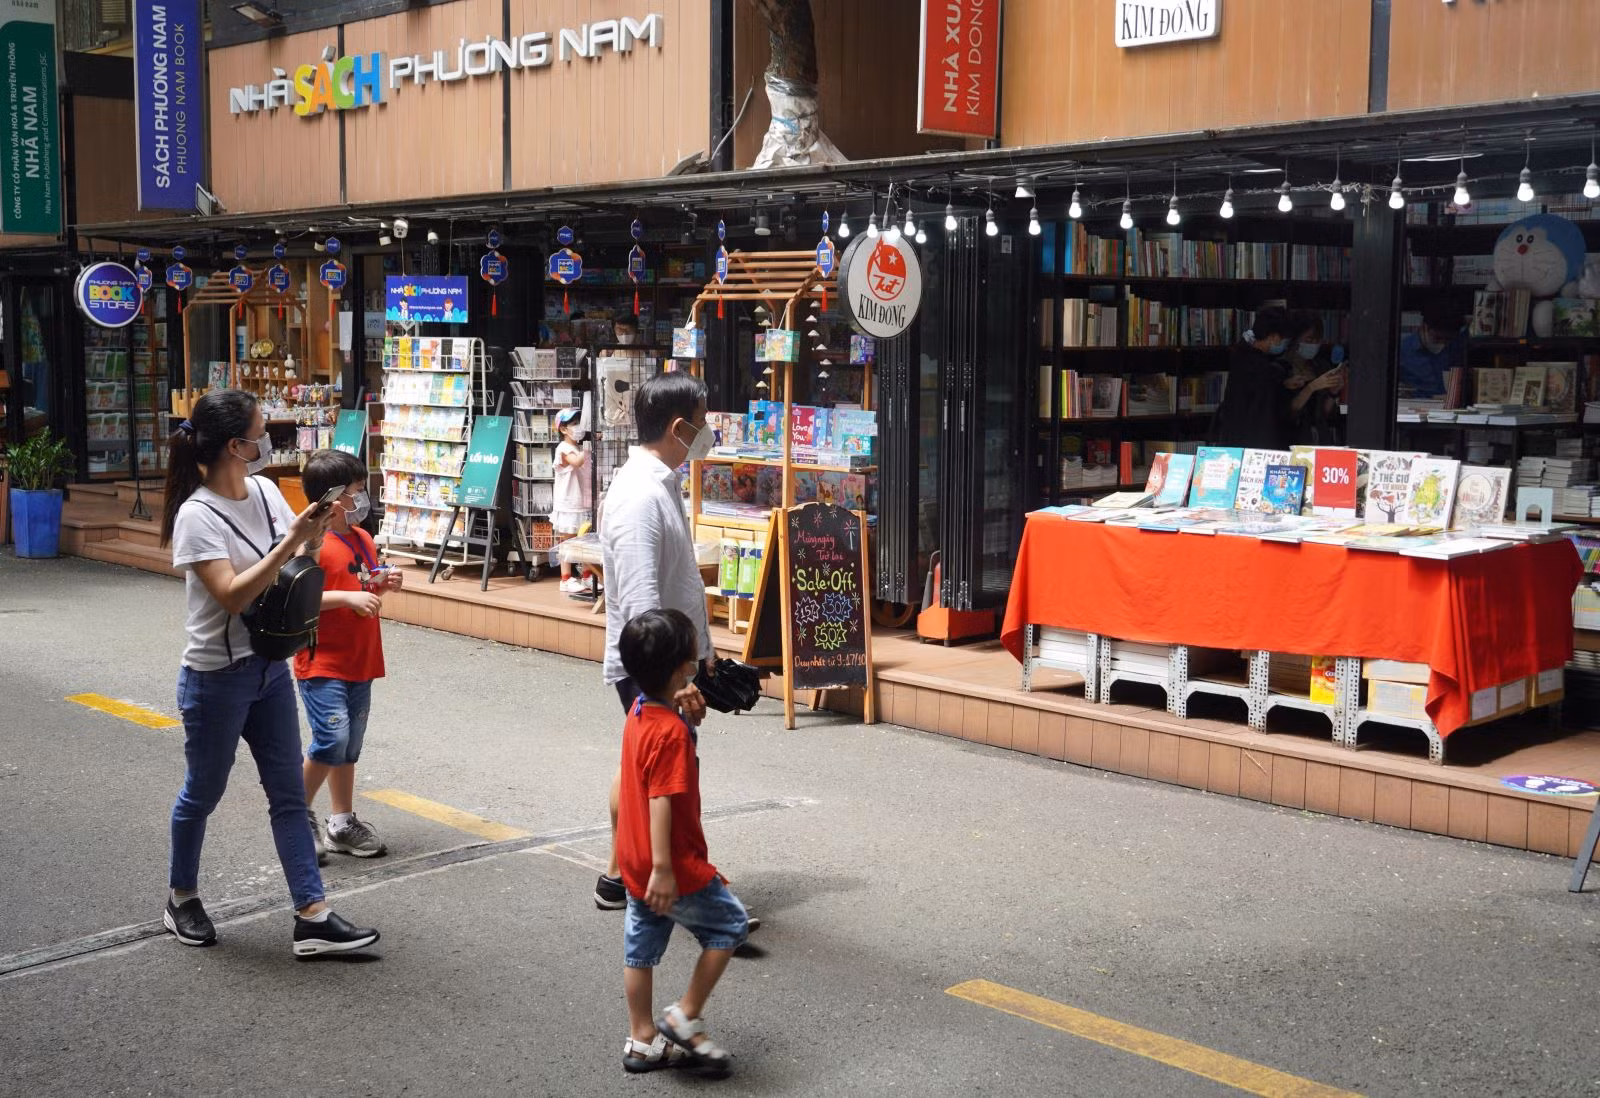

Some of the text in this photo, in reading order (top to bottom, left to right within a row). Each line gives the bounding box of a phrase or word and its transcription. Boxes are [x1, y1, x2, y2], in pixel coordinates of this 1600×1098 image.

[1121, 3, 1155, 40] KIM
[229, 13, 662, 116] NHÀ SÁCH PHƯƠNG NAM
[942, 0, 962, 112] NHÀ XU
[152, 4, 170, 188] SÁCH PHƯƠNG NAM
[174, 23, 187, 174] PHUONG NAM BOOK
[966, 73, 981, 116] KIM
[20, 86, 40, 178] NHÃ NAM
[14, 185, 20, 195] TY
[88, 285, 135, 301] BOOK
[447, 287, 463, 295] NAM
[89, 300, 135, 310] STORE
[858, 293, 878, 322] KIM
[792, 422, 808, 432] Love
[796, 415, 801, 424] I
[1322, 466, 1350, 485] 30%
[796, 568, 854, 592] Sale Off
[801, 604, 817, 619] 15%
[826, 598, 848, 615] 30%
[819, 627, 842, 643] 50%
